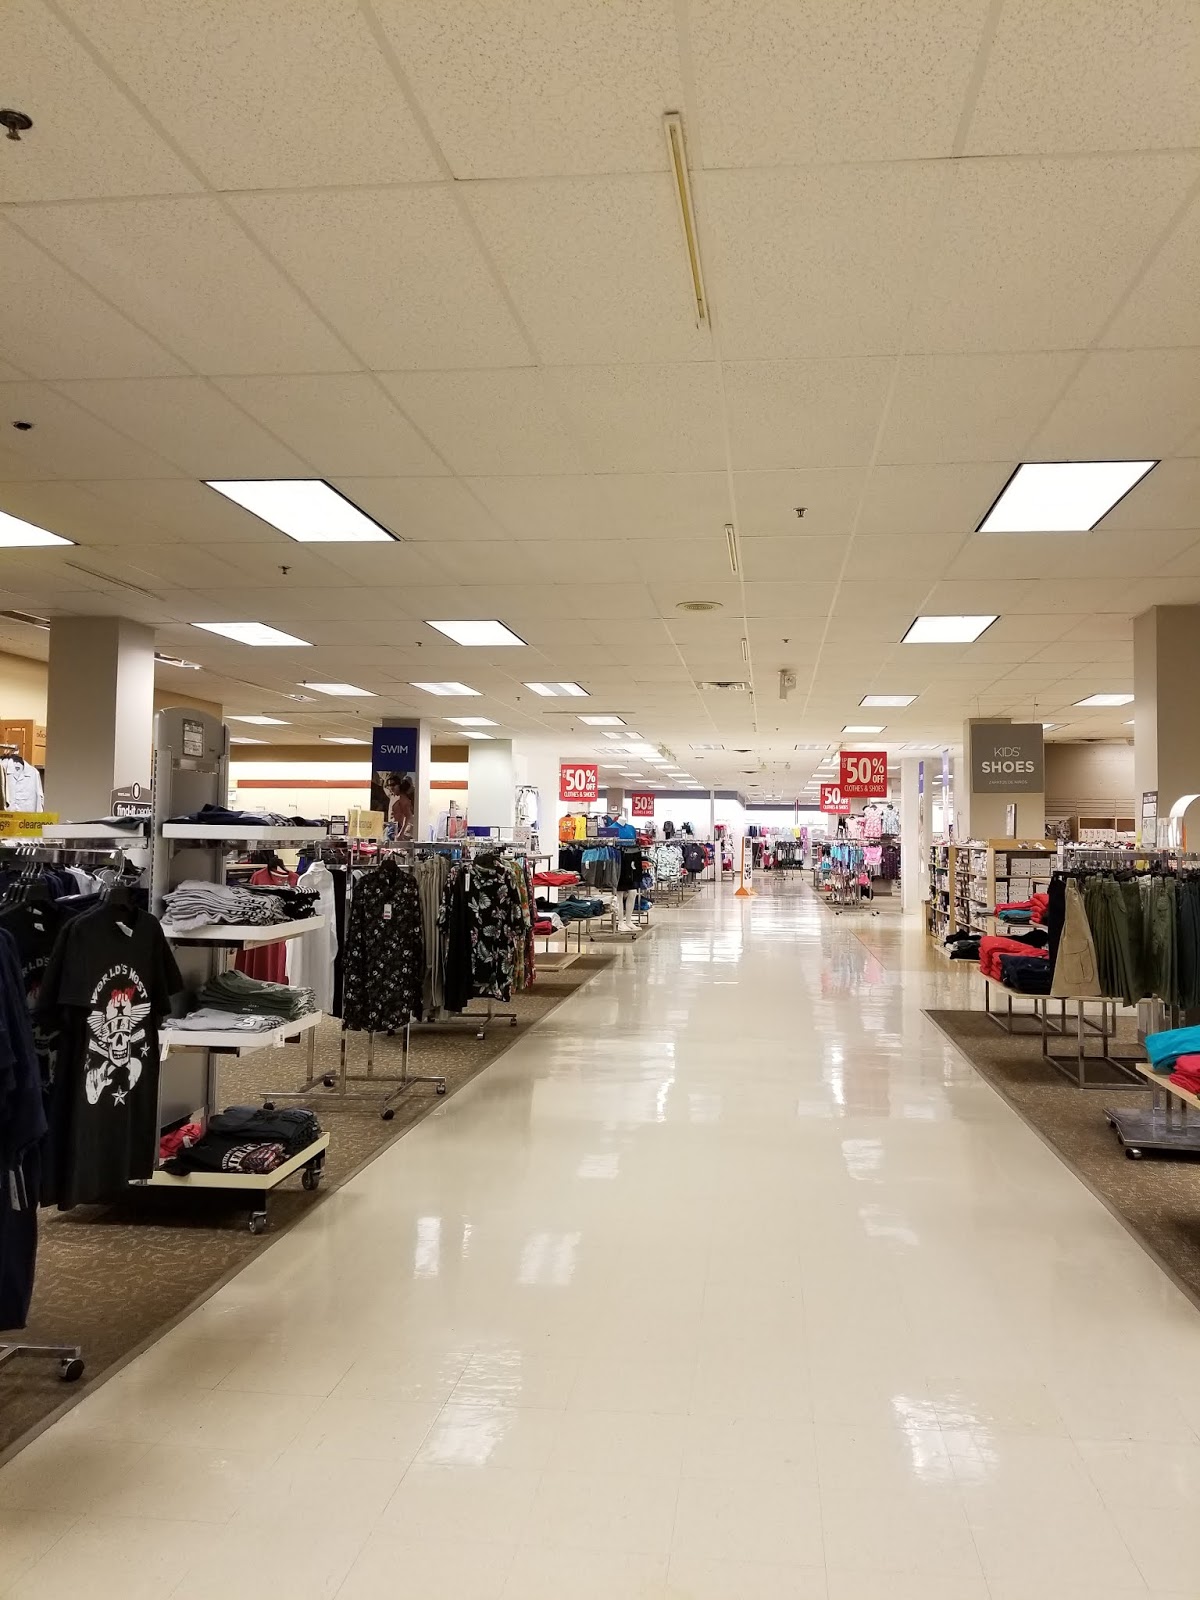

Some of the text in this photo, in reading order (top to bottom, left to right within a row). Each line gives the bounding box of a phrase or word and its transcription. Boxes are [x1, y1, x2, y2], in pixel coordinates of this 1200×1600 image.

[380, 744, 409, 754] SWIM
[994, 747, 1021, 757] KIDS'
[847, 757, 884, 783] 50%
[981, 761, 1035, 773] SHOES
[566, 769, 596, 790] 50%
[872, 775, 884, 783] OFF
[825, 788, 841, 804] 50
[117, 804, 153, 817] find-it cente
[21, 956, 50, 977] RLD'S
[90, 963, 148, 1004] WORLD'S MOST
